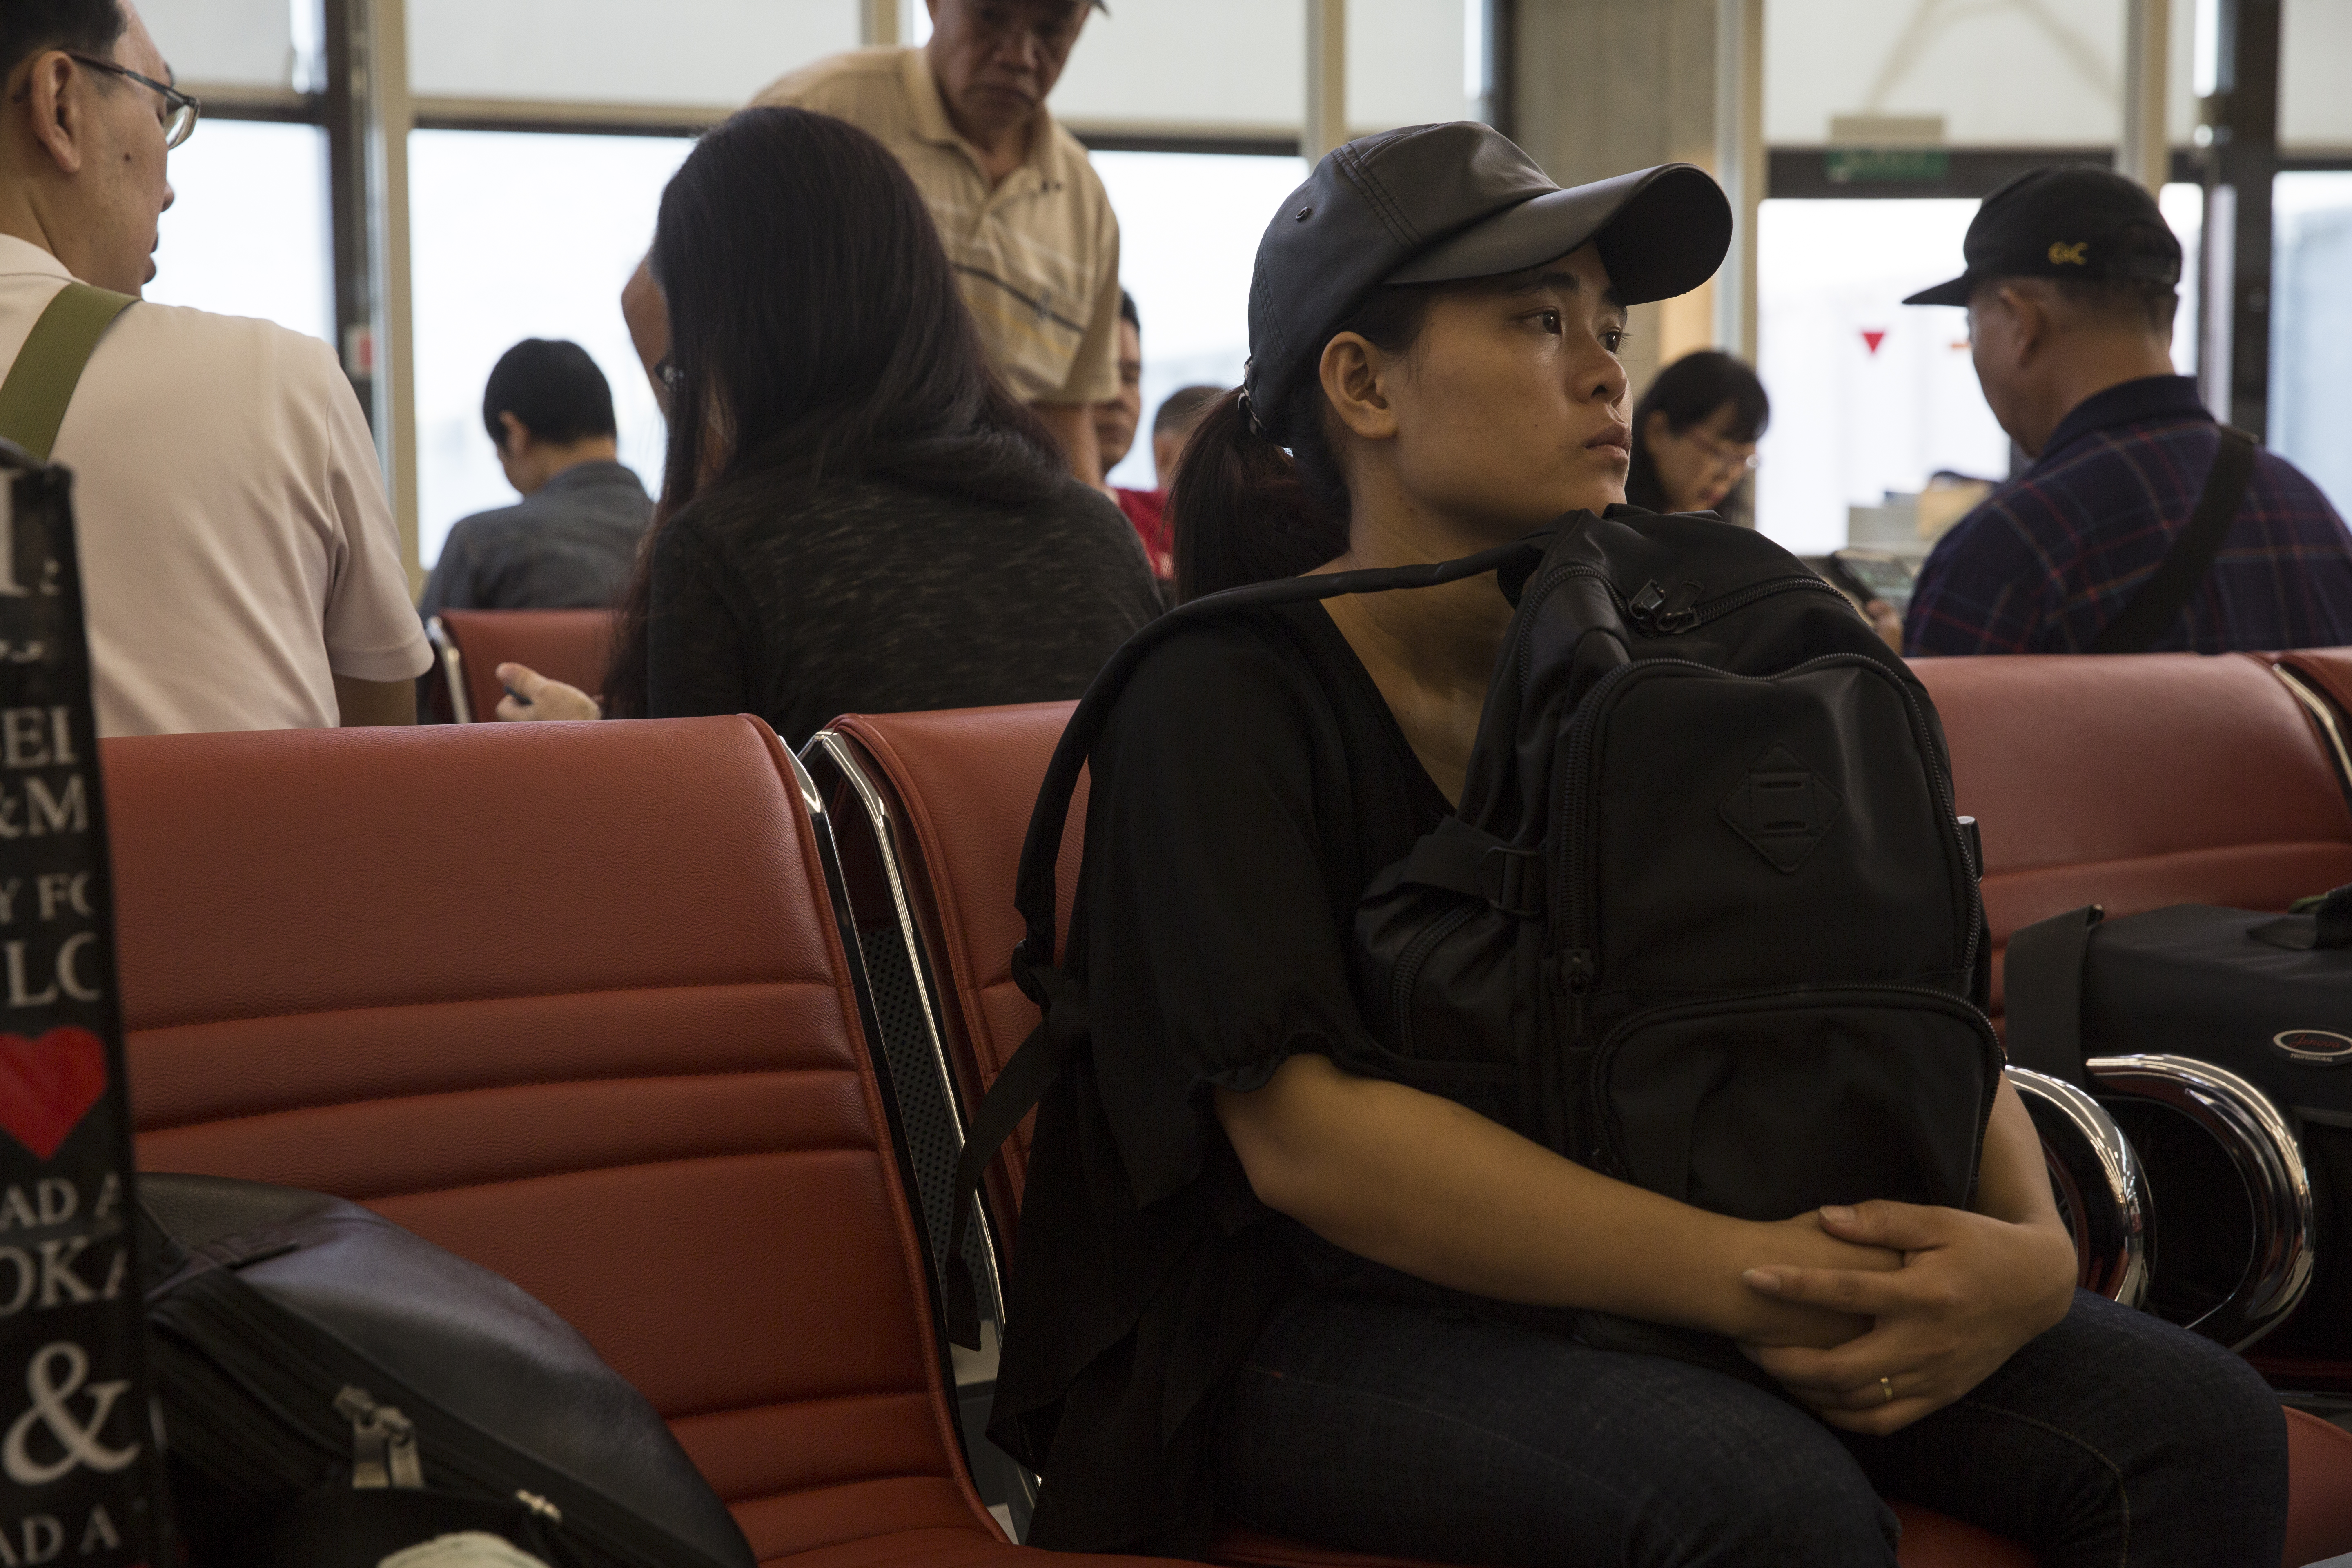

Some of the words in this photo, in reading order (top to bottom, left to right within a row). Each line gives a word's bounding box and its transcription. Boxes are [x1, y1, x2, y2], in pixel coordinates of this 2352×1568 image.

[2290, 1033, 2341, 1049] Jenova
[1, 1340, 143, 1486] &
[79, 1503, 122, 1554] A
